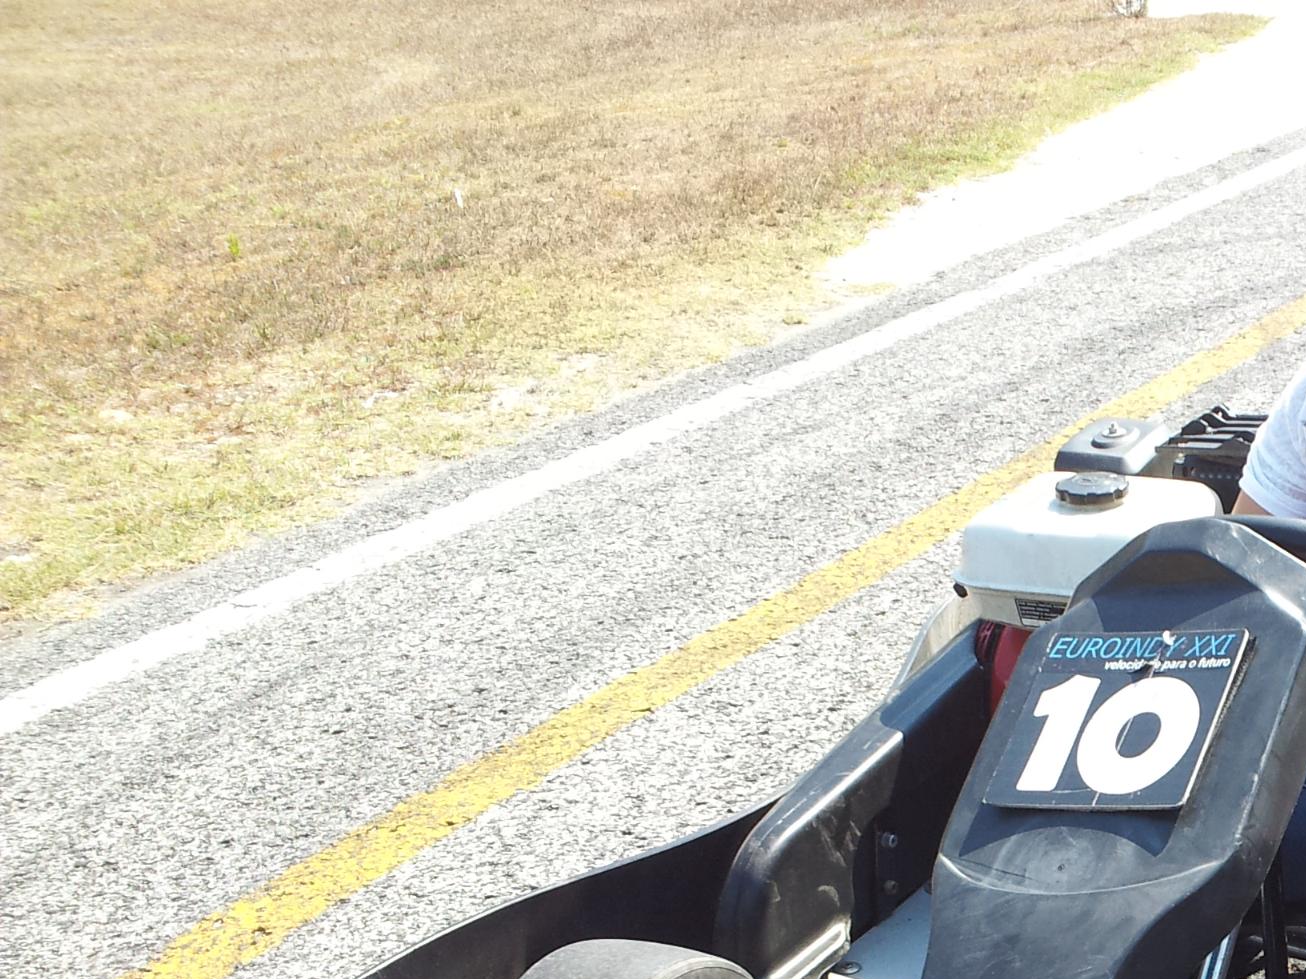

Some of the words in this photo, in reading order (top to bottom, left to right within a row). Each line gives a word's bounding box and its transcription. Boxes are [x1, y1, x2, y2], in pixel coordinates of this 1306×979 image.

[1050, 635, 1186, 659] EUROINDY
[1184, 633, 1236, 657] XXI
[1160, 660, 1187, 672] para
[1188, 659, 1197, 669] o
[1197, 656, 1231, 669] futuro
[1015, 674, 1201, 795] 10
